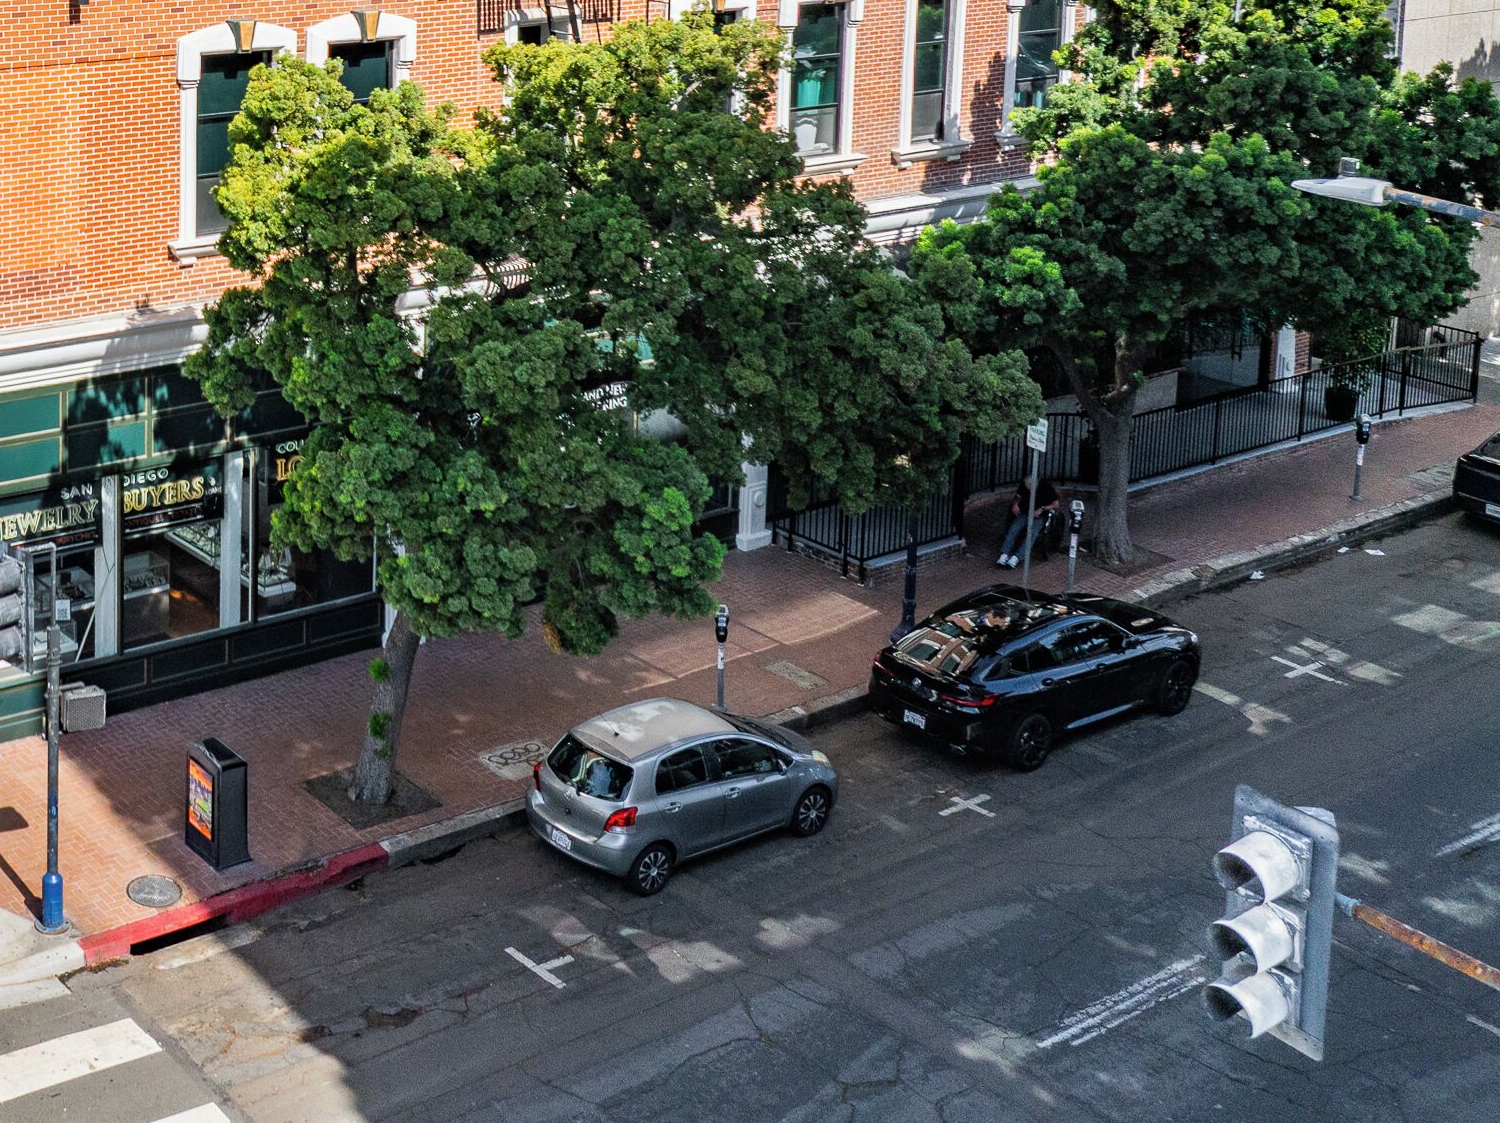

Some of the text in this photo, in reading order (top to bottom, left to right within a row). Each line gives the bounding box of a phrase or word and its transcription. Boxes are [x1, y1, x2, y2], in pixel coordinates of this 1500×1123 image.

[60, 468, 169, 500] SAN DIEGO
[123, 476, 205, 514] BUYERS
